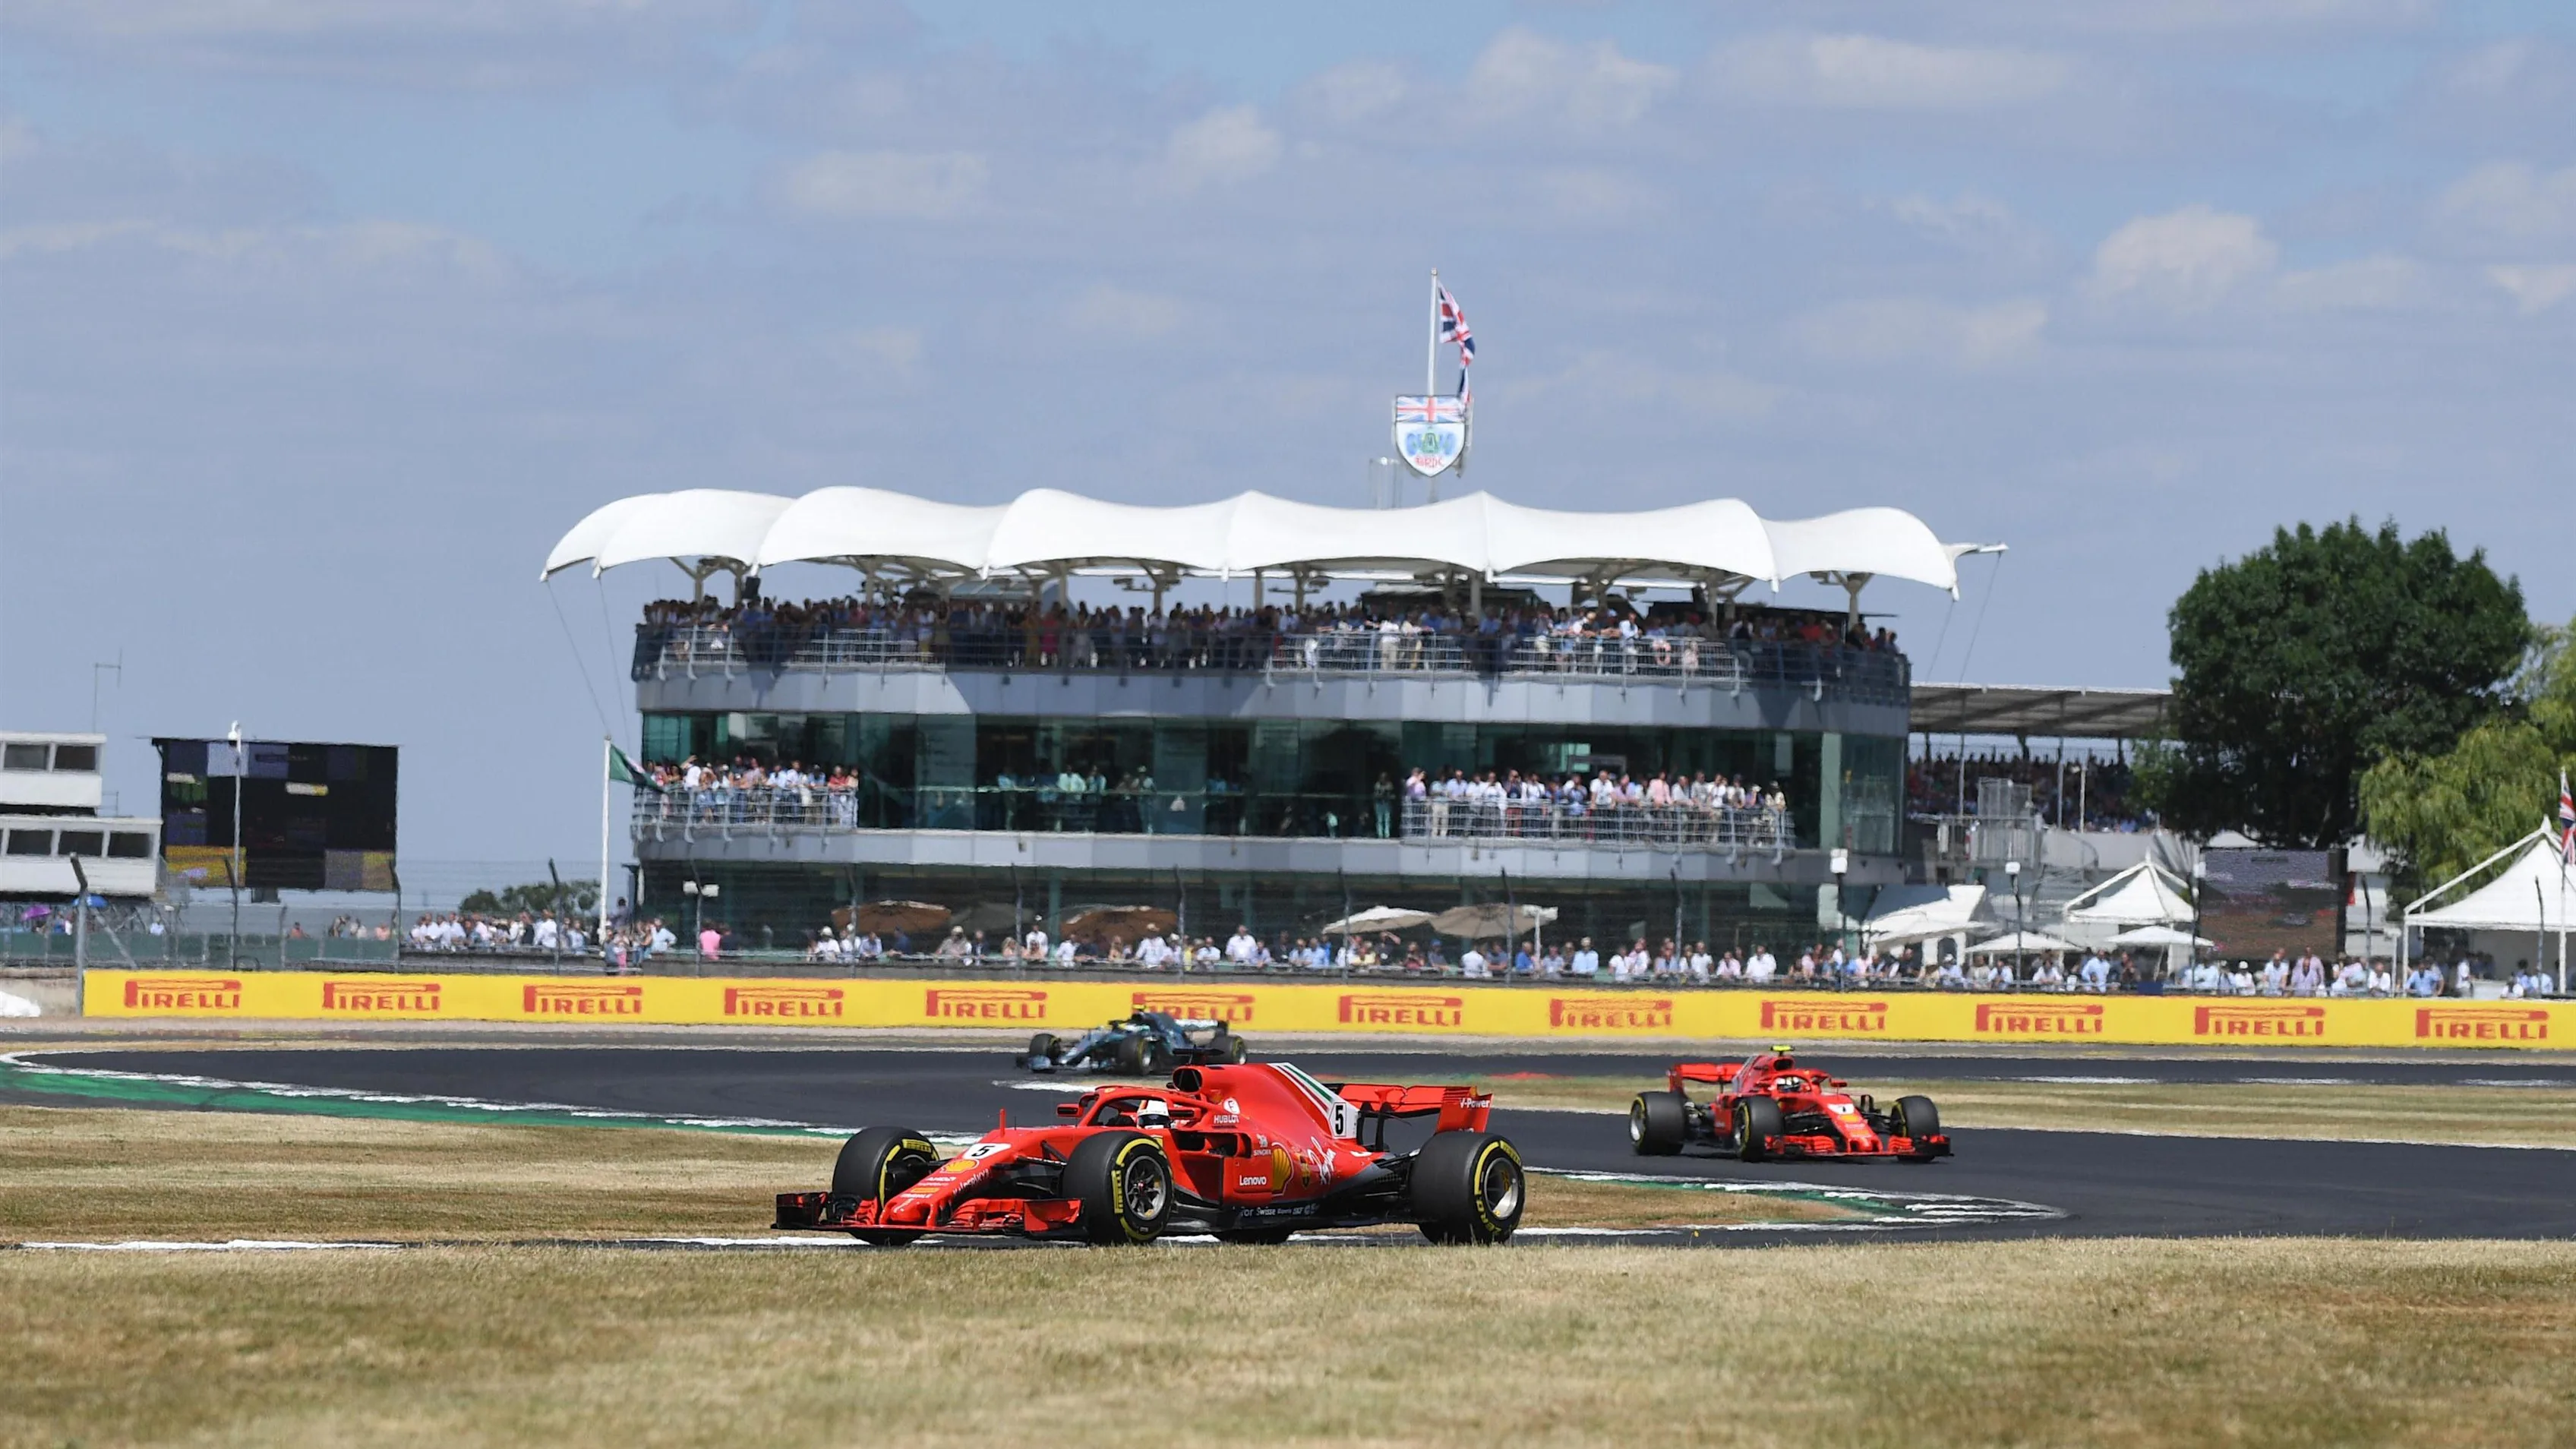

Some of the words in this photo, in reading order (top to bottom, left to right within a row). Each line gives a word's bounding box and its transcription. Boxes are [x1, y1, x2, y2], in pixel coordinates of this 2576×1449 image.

[124, 980, 243, 1009] PIRELLI
[323, 982, 443, 1012] PIRELLI
[523, 985, 643, 1015] PIRELLI
[724, 987, 846, 1018] PIRELLI
[926, 990, 1050, 1020] PIRELLI
[1338, 996, 1464, 1027] PIRELLI
[1550, 999, 1675, 1028] PIRELLI
[1760, 1001, 1889, 1031] PIRELLI
[1976, 1004, 2105, 1034] PIRELLI
[2194, 1006, 2325, 1037] PIRELLI
[2417, 1009, 2549, 1040] PIRELLI
[1460, 1097, 1491, 1108] V-Power
[1214, 1115, 1239, 1123] HUBLOT
[1335, 1105, 1343, 1135] 5
[971, 1145, 995, 1157] 5
[1239, 1175, 1267, 1185] Lenovo
